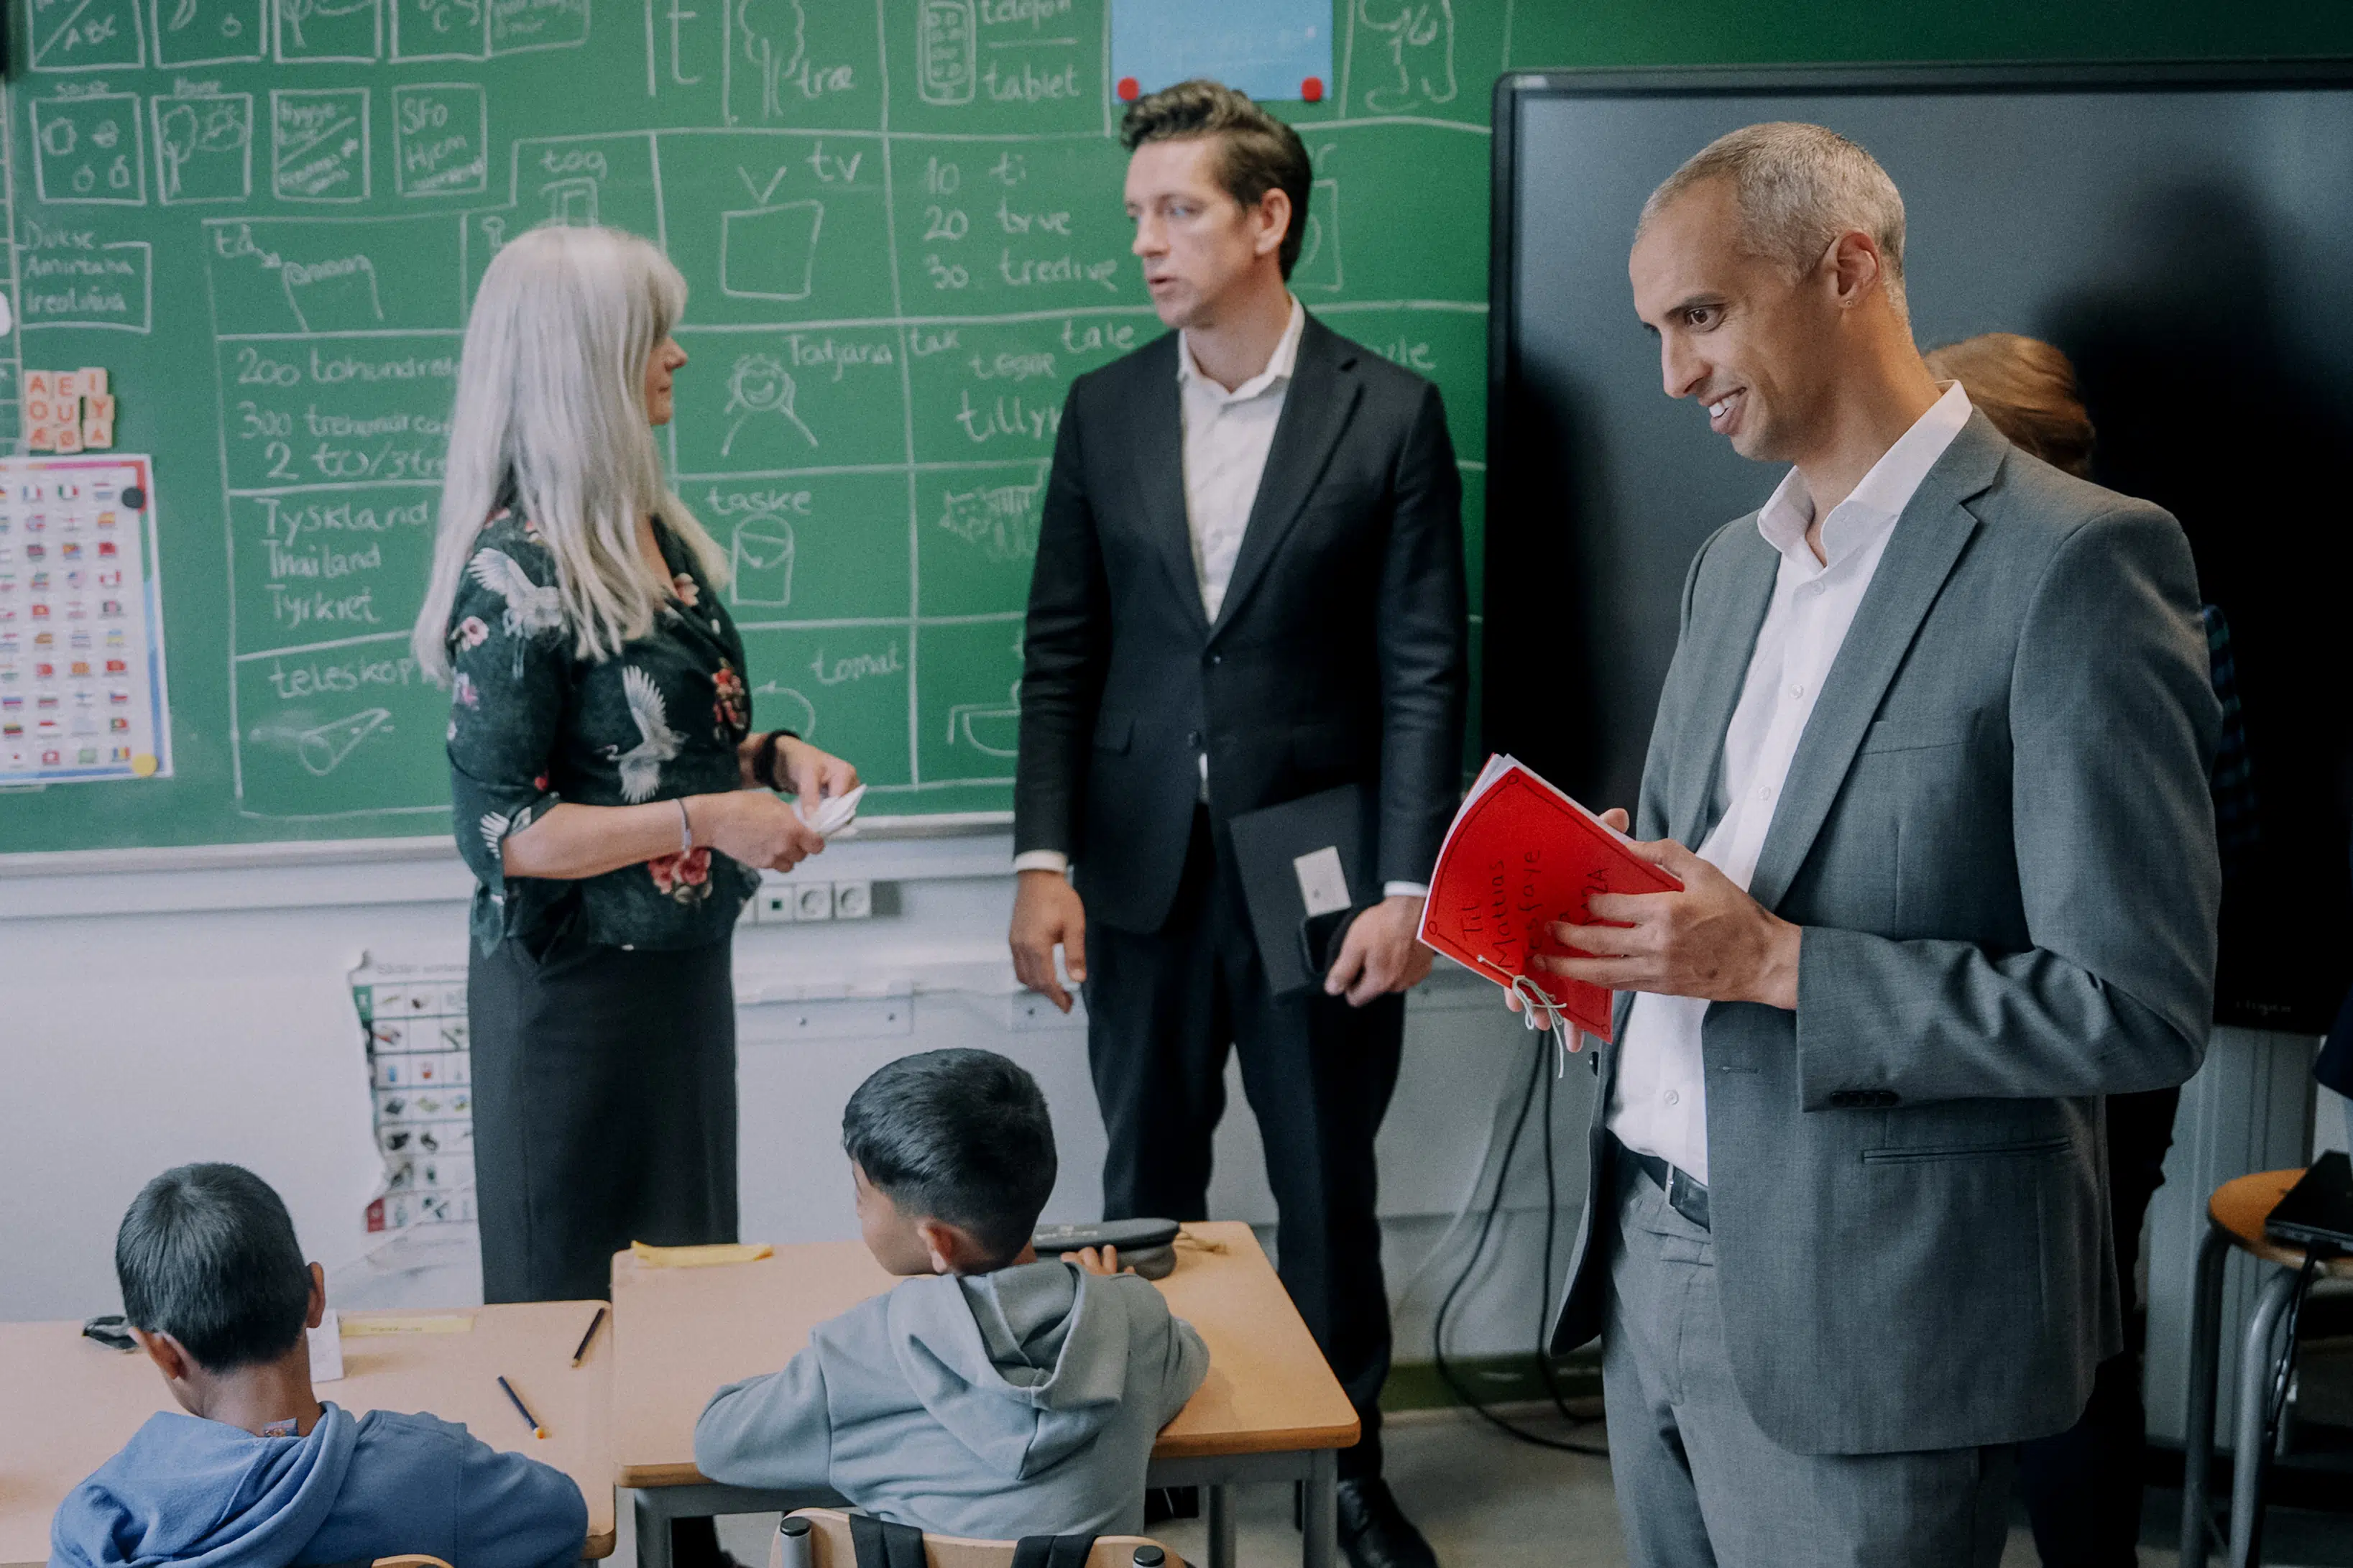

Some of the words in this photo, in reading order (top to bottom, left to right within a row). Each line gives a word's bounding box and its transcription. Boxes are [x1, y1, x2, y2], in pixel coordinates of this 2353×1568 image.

[983, 60, 1080, 102] tablet
[539, 149, 608, 180] tag
[925, 156, 962, 194] 10
[987, 152, 1026, 186] ti
[922, 205, 969, 241] 20
[995, 198, 1072, 236] tyve
[923, 253, 970, 290] 30
[1060, 320, 1135, 353] tale
[237, 347, 302, 387] 200
[264, 441, 299, 480] 2
[254, 496, 429, 547] Tyskland
[707, 487, 812, 515] taske
[261, 540, 382, 578] Thailand
[264, 583, 381, 629] Tyrkiet
[1460, 900, 1483, 942] Til
[1489, 859, 1517, 969] Mattias
